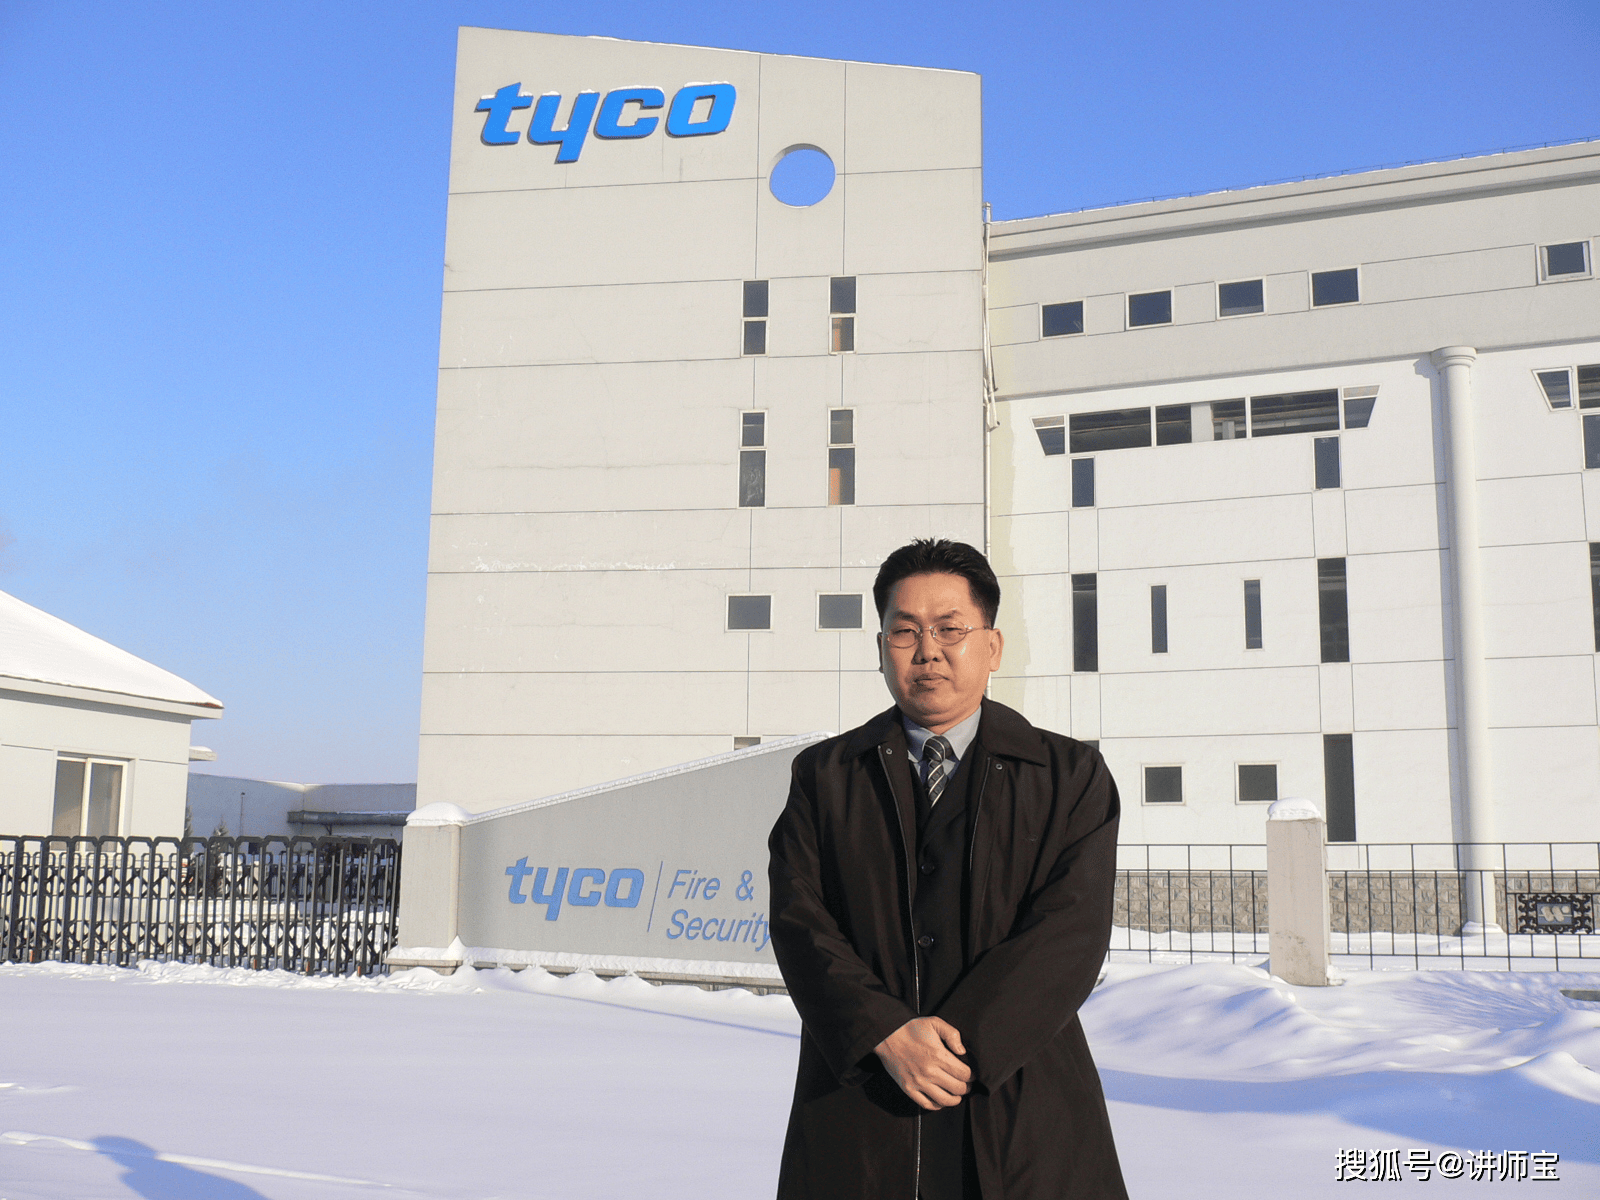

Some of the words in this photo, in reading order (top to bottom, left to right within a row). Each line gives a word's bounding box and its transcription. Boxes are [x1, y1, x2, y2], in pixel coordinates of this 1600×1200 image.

[475, 82, 736, 163] tyco
[505, 856, 644, 921] tyco
[667, 869, 720, 900] Fire
[735, 870, 754, 901] &
[666, 909, 771, 952] Security
